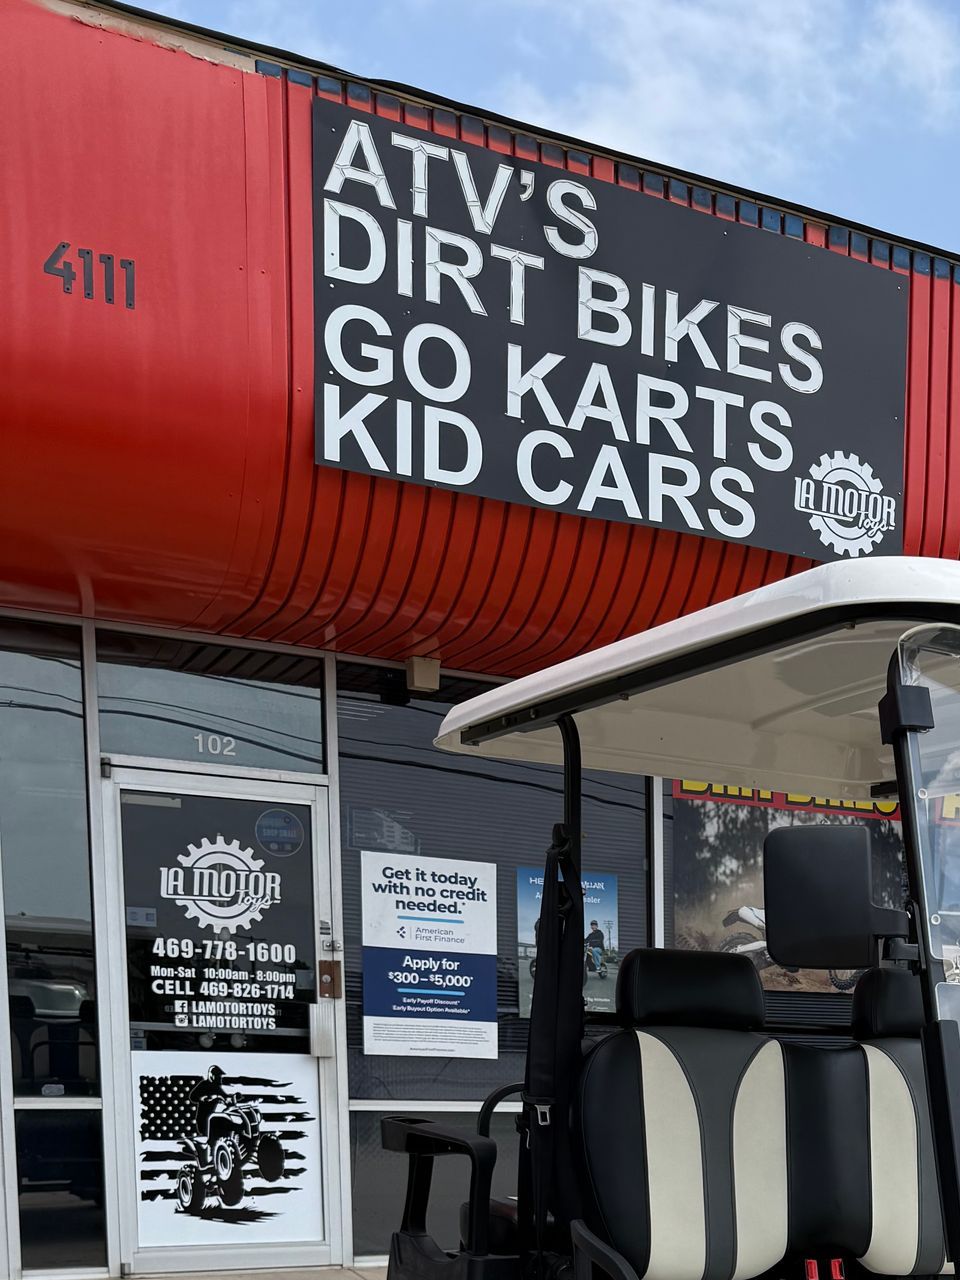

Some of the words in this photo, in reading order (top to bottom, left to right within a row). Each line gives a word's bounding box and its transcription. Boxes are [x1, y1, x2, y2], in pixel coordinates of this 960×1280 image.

[323, 119, 599, 259] ATV'S
[44, 242, 135, 310] 4111
[323, 197, 545, 326] DIRT
[578, 266, 824, 394] BIKES
[323, 304, 472, 403] GO
[507, 342, 794, 472] KARTS
[323, 382, 483, 486] KID
[516, 429, 756, 538] CARS
[822, 482, 896, 526] MOTOR
[857, 510, 889, 537] Toys
[193, 733, 236, 756] 102
[160, 867, 184, 899] LA
[193, 868, 281, 899] MOTOR
[382, 866, 412, 881] Get
[415, 867, 427, 882] it
[430, 871, 478, 889] today
[236, 889, 272, 912] Toys
[372, 880, 410, 896] with
[415, 886, 436, 897] no
[440, 888, 488, 902] credit
[415, 927, 454, 936] American
[415, 933, 433, 942] First
[434, 935, 465, 943] Finance
[152, 937, 296, 963] 469-778-1600
[150, 965, 196, 978] Mon-Sat
[203, 968, 249, 980] 10:00am
[256, 970, 296, 983] 8:00pm
[402, 955, 440, 971] Apply
[441, 958, 460, 970] for
[151, 979, 195, 995] CELL
[200, 981, 295, 999] 469-826-1714
[388, 971, 419, 984] $300
[191, 1001, 276, 1016] LAMOTORTOYS
[192, 1015, 276, 1030] LAMOTORTOYS
